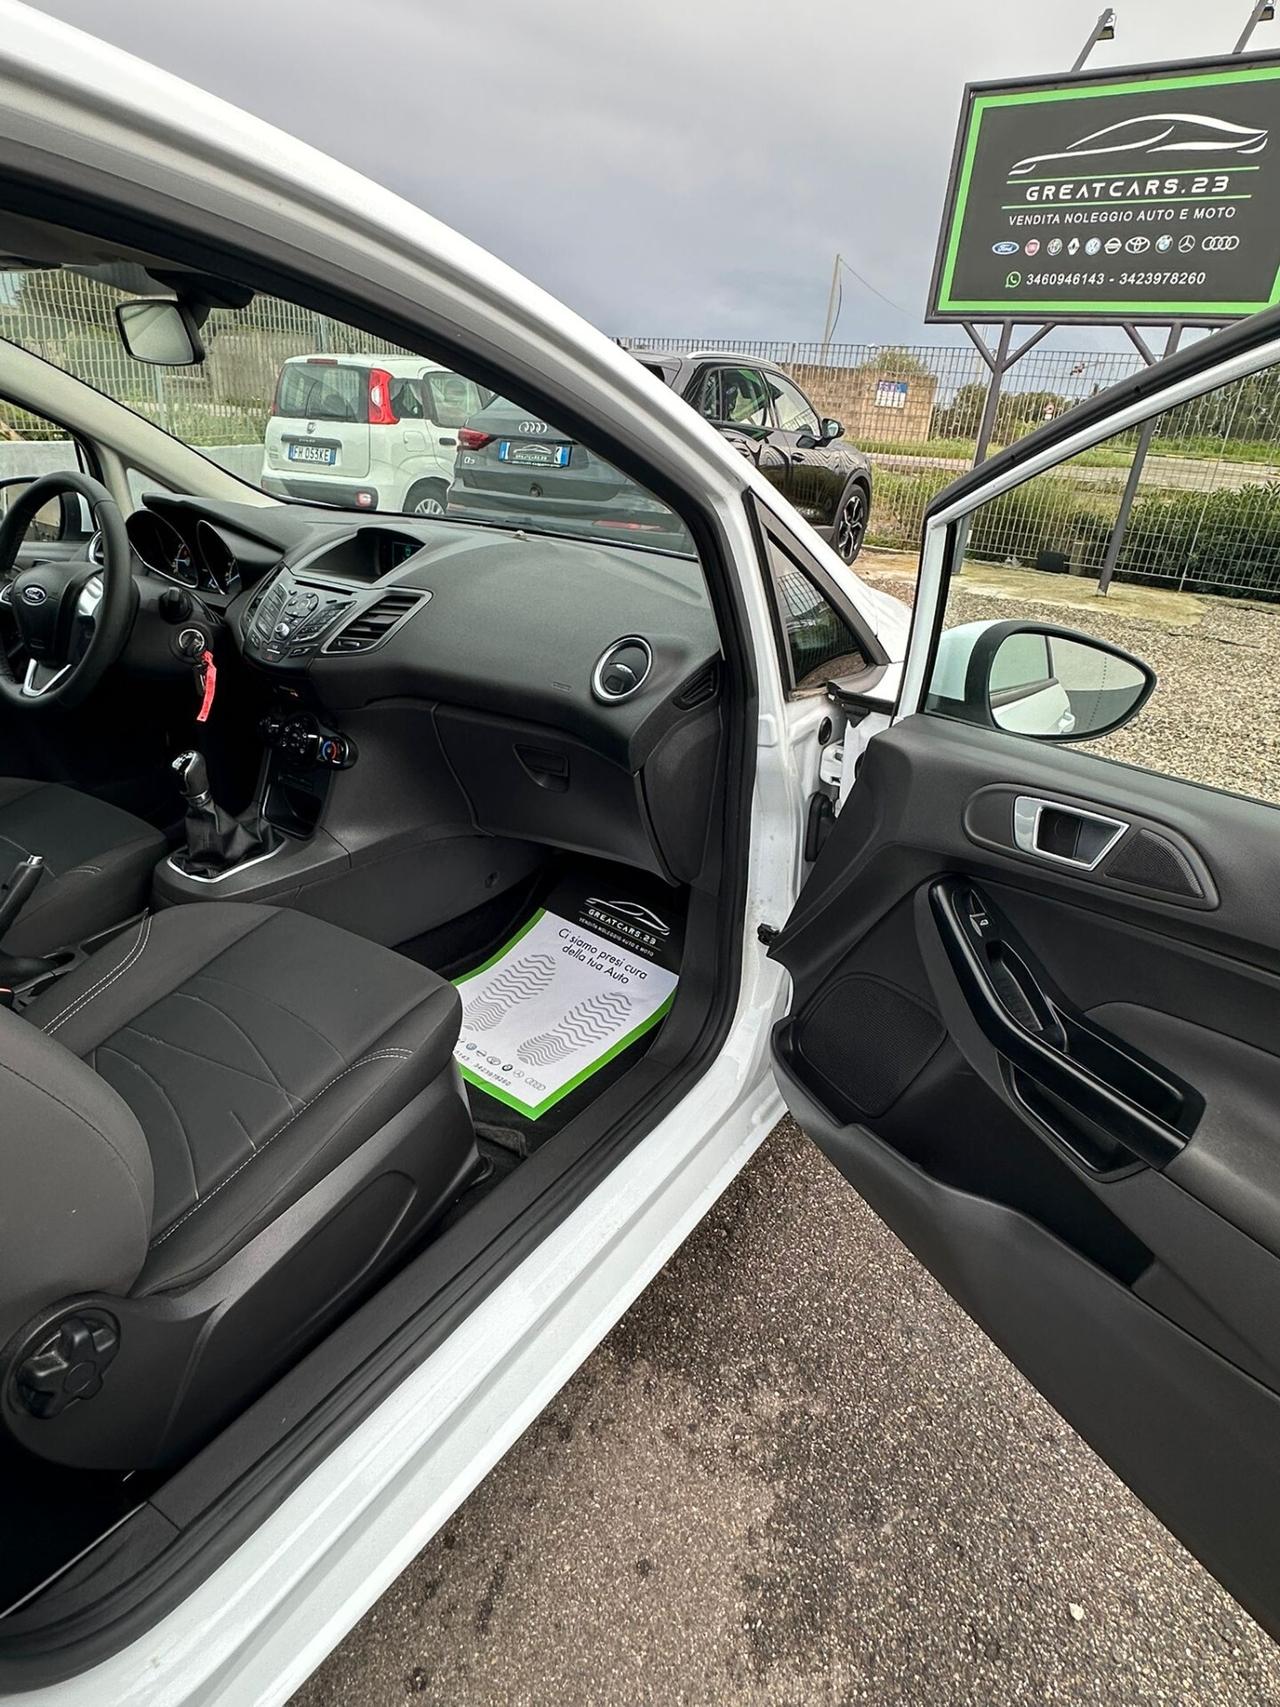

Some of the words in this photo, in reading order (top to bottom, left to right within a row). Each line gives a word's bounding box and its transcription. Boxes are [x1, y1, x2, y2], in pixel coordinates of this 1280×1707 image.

[1025, 175, 1229, 201] GREATCARS.23
[1008, 213, 1061, 226] VENDITA
[1064, 210, 1133, 224] NOLEGGIO
[1136, 208, 1174, 222] AUTO
[1179, 208, 1189, 220] E
[1193, 206, 1236, 219] MOTO
[1026, 273, 1105, 285] 3460946143
[1119, 271, 1206, 285] 3423978260
[588, 908, 657, 945] GREATCARS.23
[558, 928, 571, 939] Ci
[569, 935, 598, 954] siamo
[596, 951, 626, 967] presi
[624, 964, 648, 980] cura
[562, 944, 586, 962] della
[586, 957, 604, 971] tua
[603, 966, 629, 984] Auto
